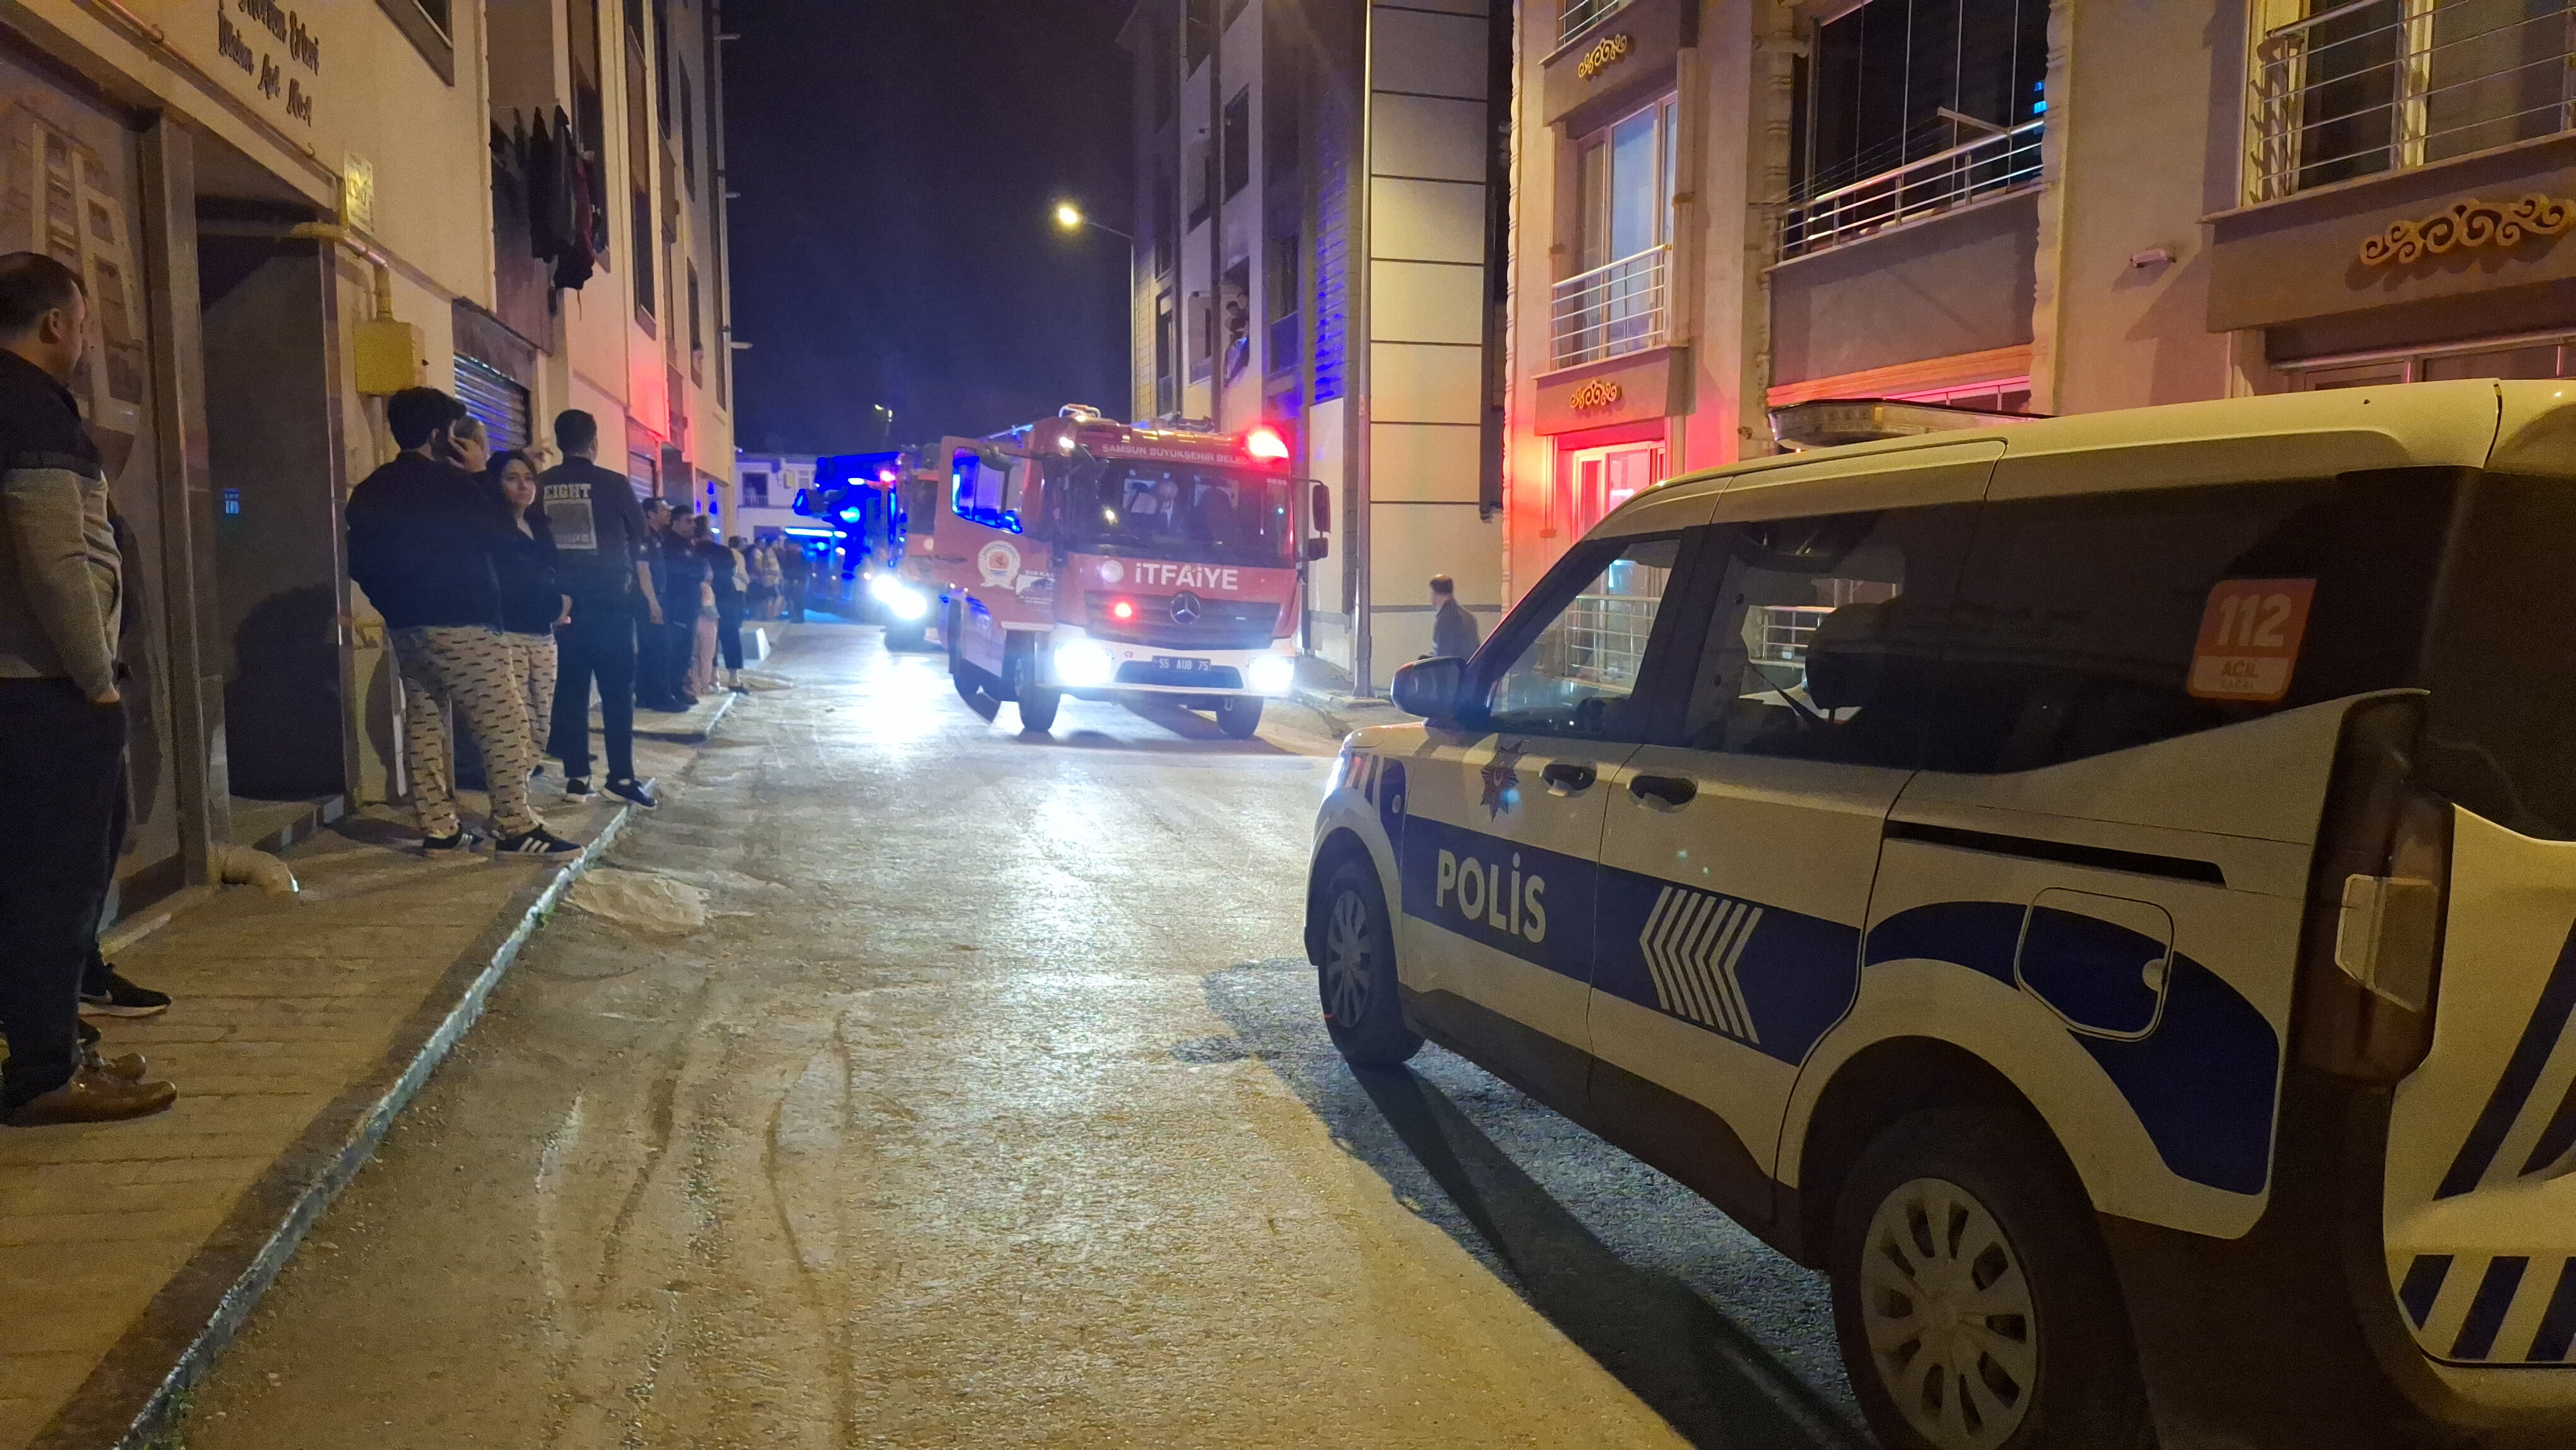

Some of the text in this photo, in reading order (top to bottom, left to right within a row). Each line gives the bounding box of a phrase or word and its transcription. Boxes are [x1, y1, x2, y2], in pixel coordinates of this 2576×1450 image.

[1102, 444, 1147, 455] SAMSUN
[2216, 593, 2292, 647] 112
[1159, 658, 1170, 669] 55
[1197, 661, 1209, 672] 75
[1436, 848, 1546, 943] POLİS
